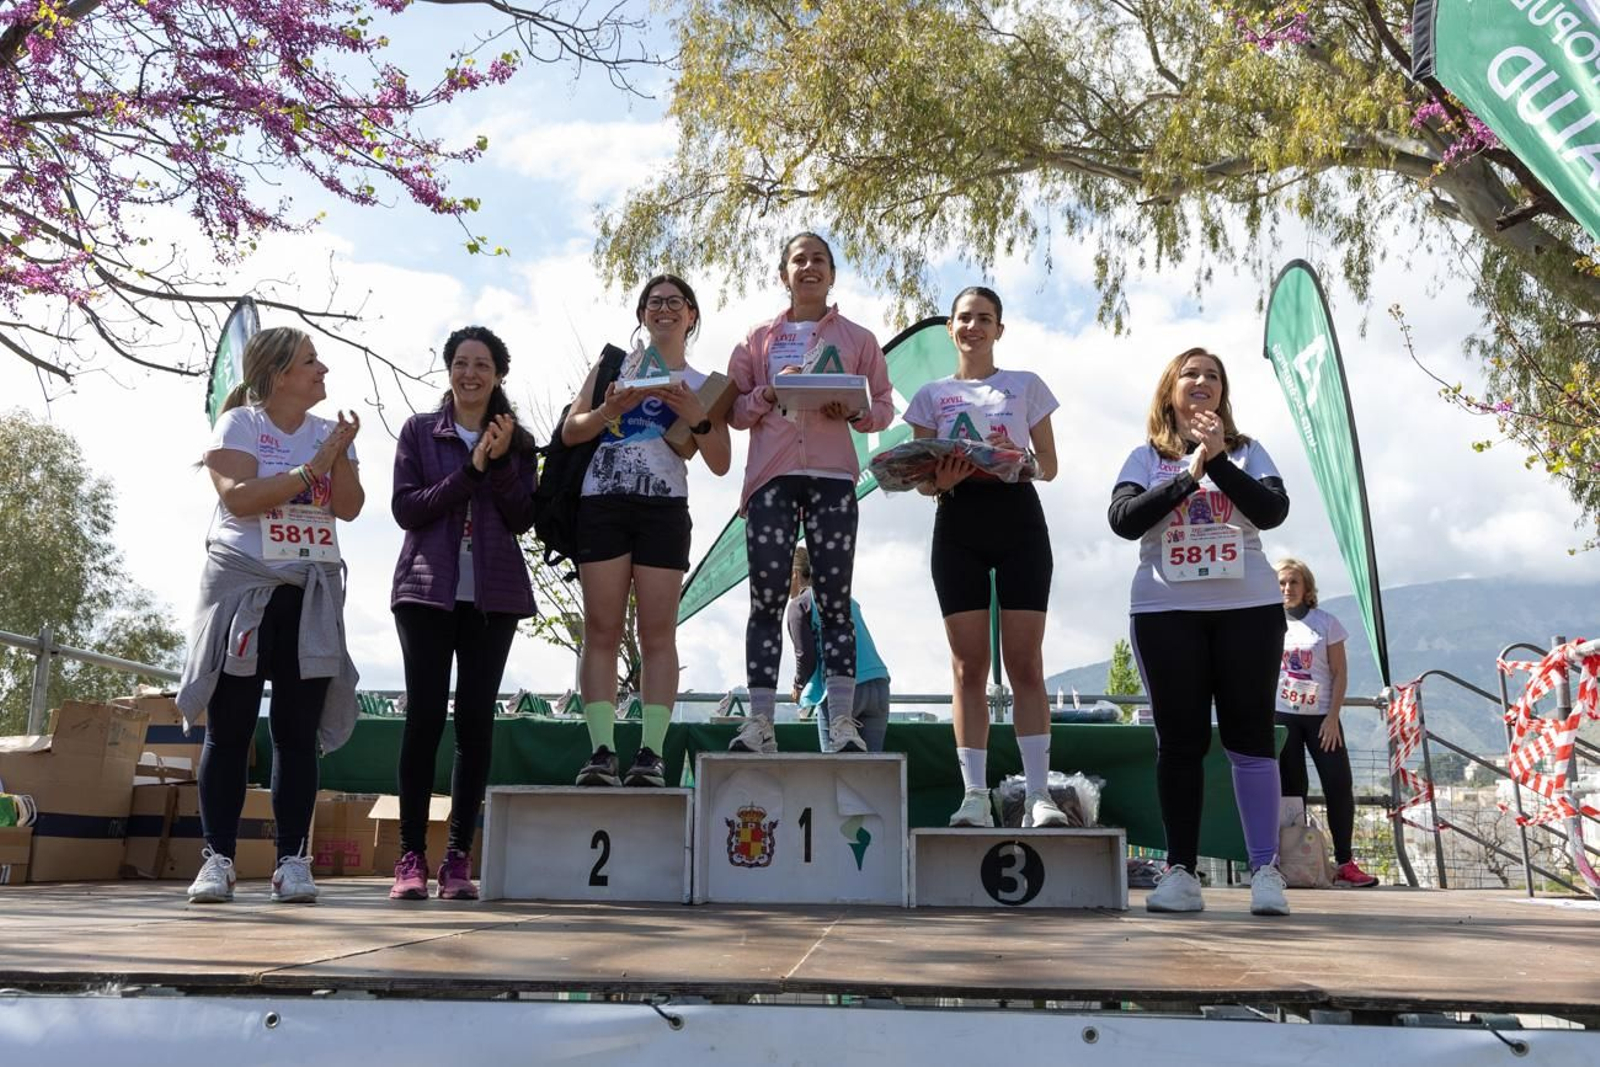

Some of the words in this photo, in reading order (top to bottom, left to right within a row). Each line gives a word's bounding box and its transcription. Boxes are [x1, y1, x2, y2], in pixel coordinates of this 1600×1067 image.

[269, 523, 334, 546] 5812
[1169, 543, 1238, 566] 5815
[1281, 688, 1316, 706] 5813
[798, 806, 813, 863] 1
[588, 829, 611, 887] 2
[997, 844, 1028, 902] 3
